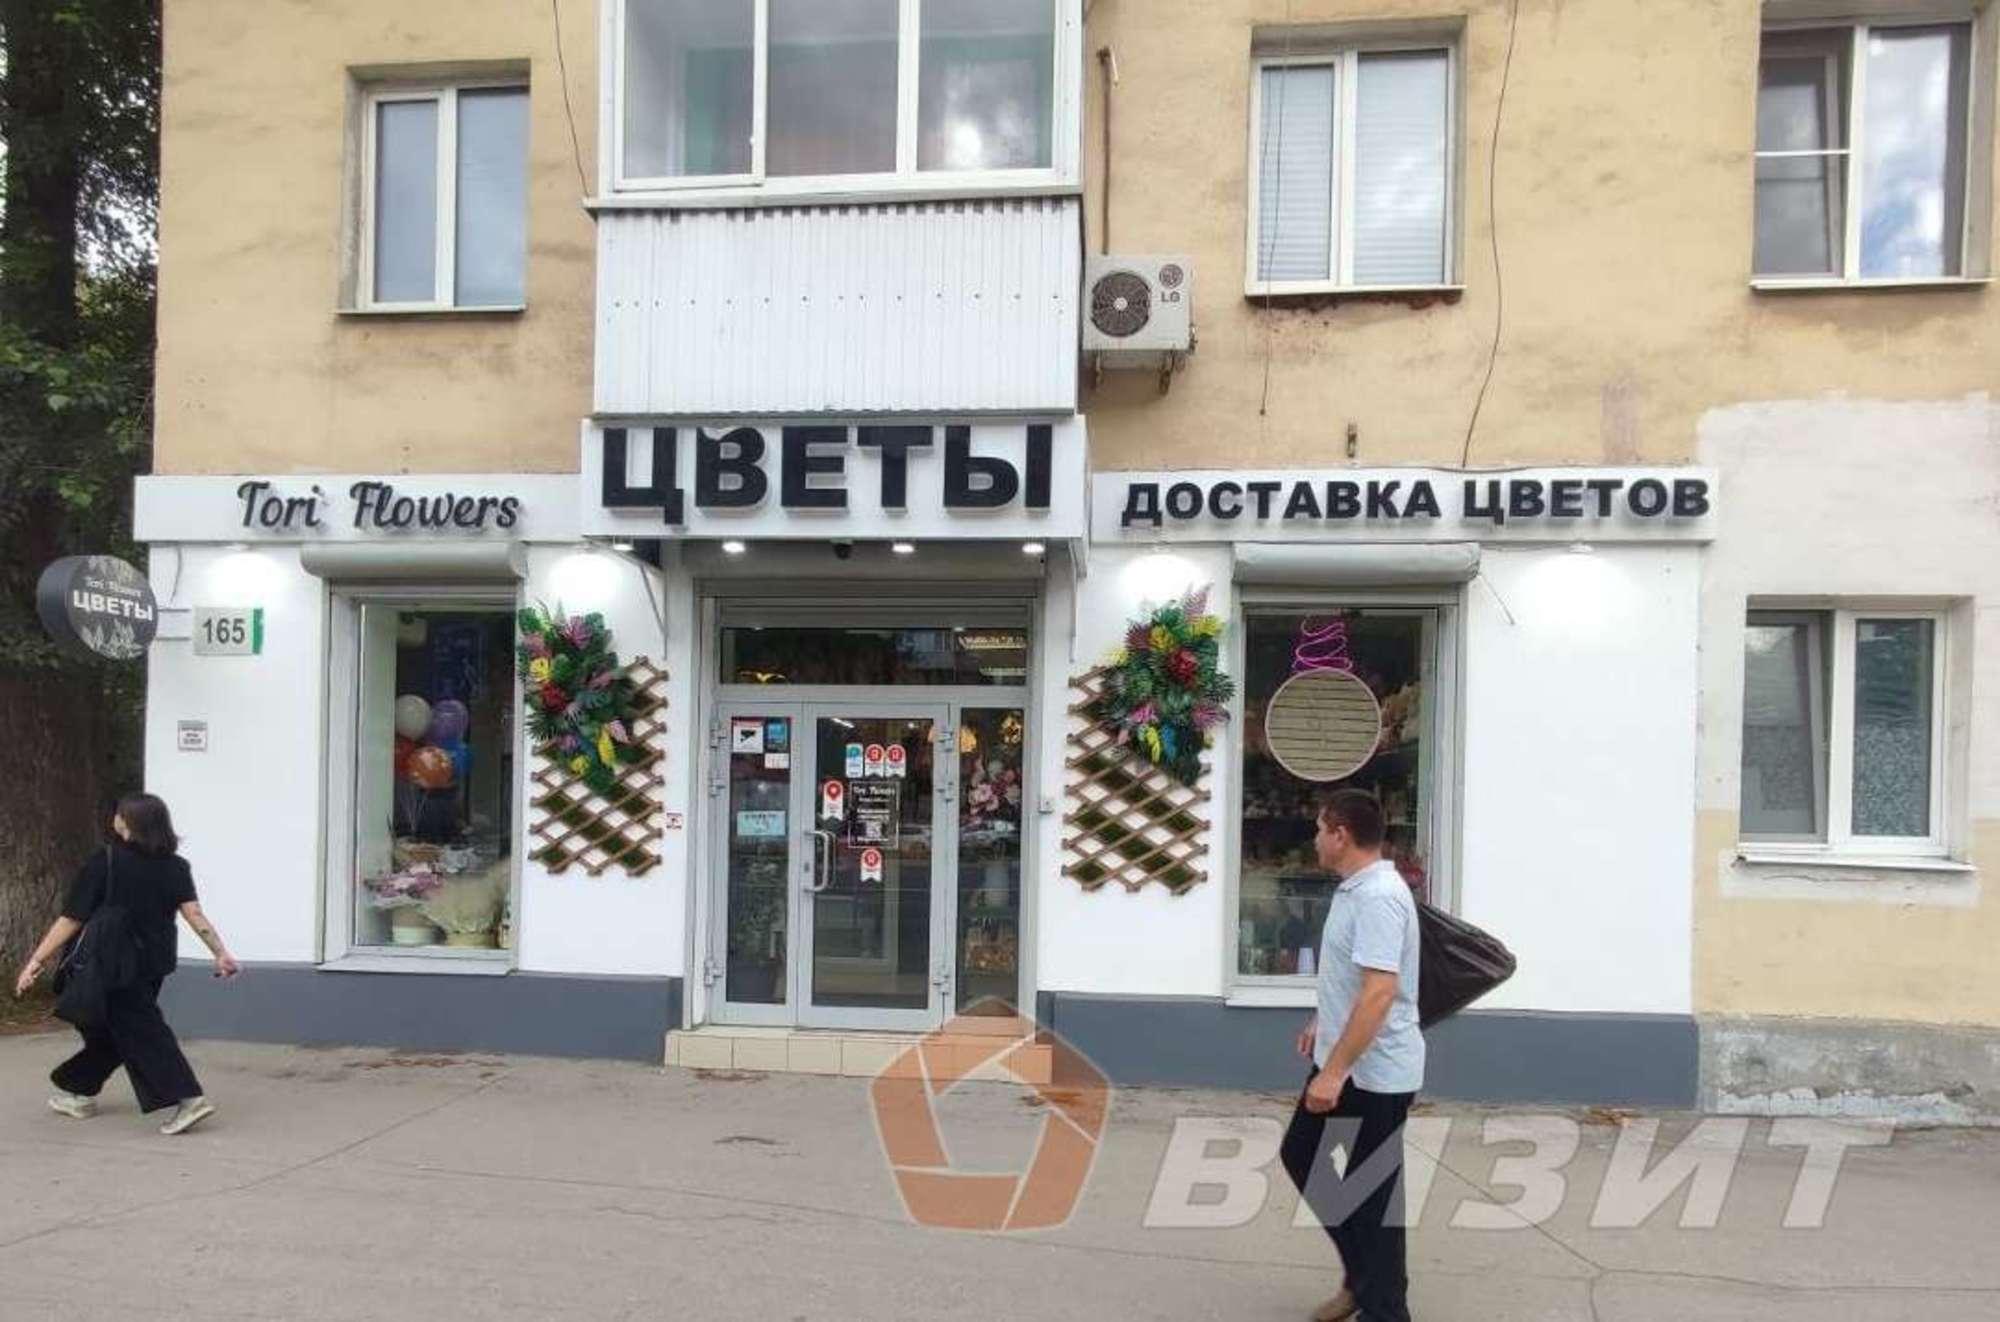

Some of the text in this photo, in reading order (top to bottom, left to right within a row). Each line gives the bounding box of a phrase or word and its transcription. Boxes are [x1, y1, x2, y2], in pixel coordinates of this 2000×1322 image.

[602, 425, 1052, 525] ЦВЕТЫ
[237, 481, 519, 528] Tori Flowers
[1121, 479, 1711, 527] ДОСТАВКА ЦВЕТОВ
[73, 589, 153, 621] ЦВЕТЫ
[203, 618, 246, 644] 165
